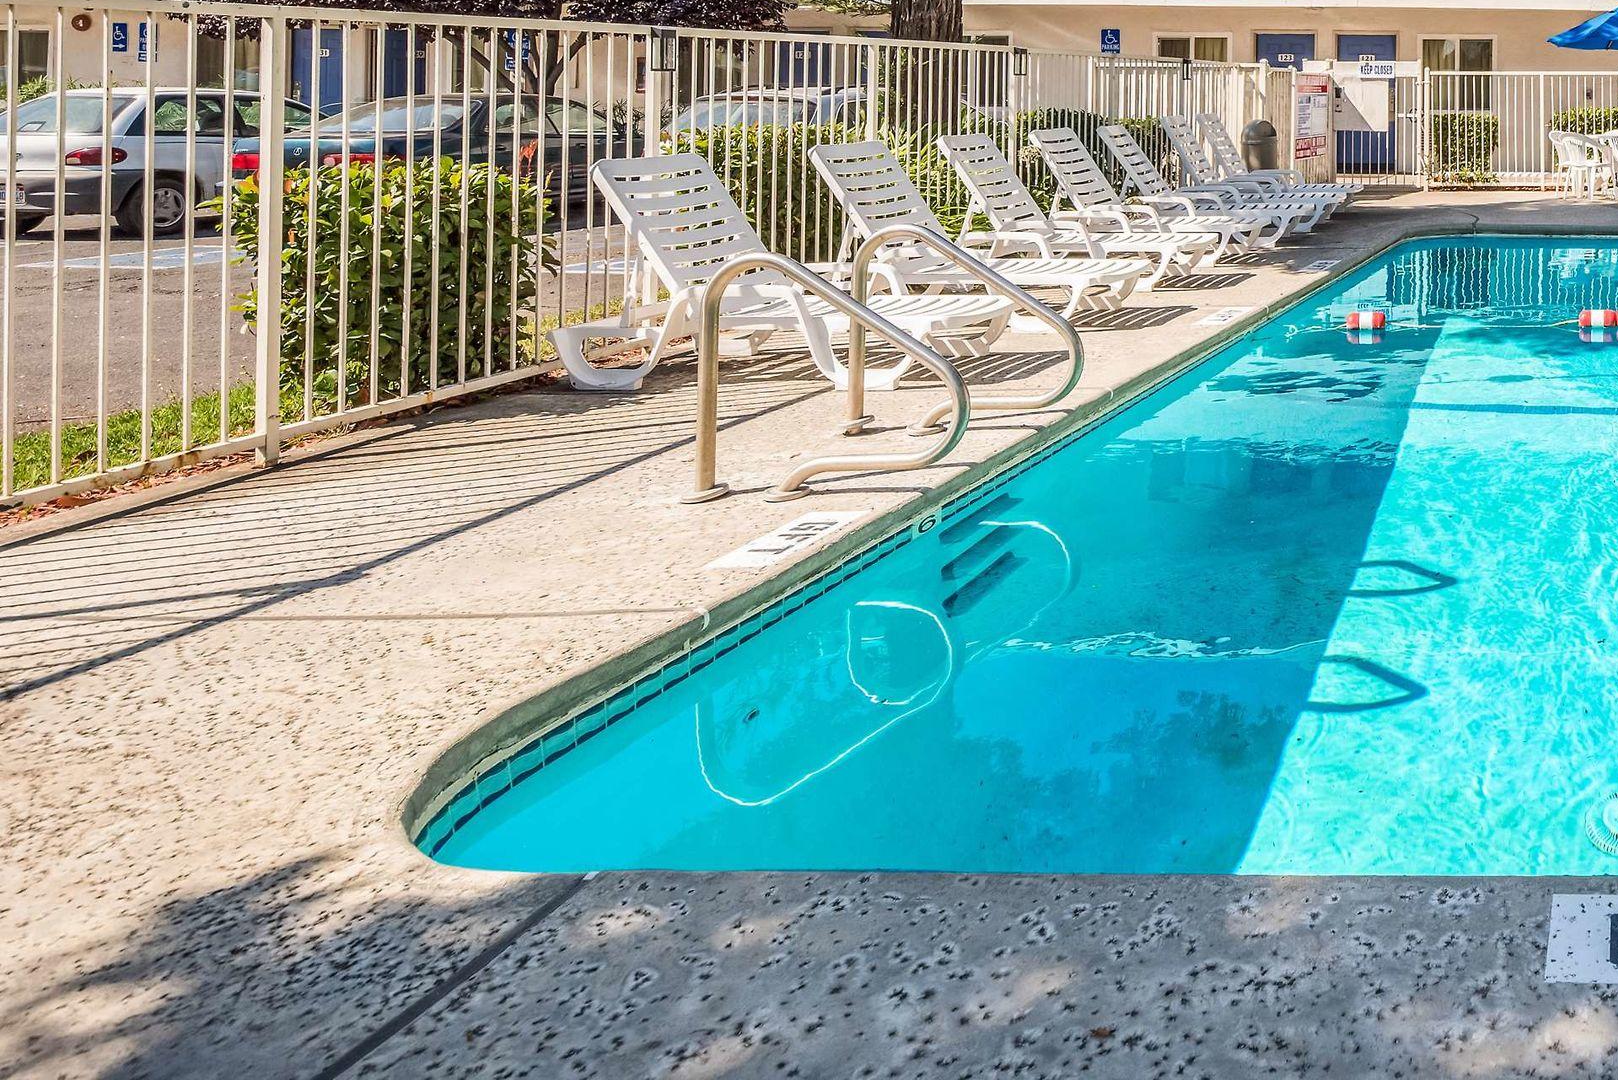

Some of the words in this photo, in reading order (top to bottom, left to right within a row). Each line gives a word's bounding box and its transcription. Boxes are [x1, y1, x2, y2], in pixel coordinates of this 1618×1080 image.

[1360, 65, 1373, 75] KEEP
[1374, 65, 1393, 75] CLOSED
[917, 514, 937, 534] 6
